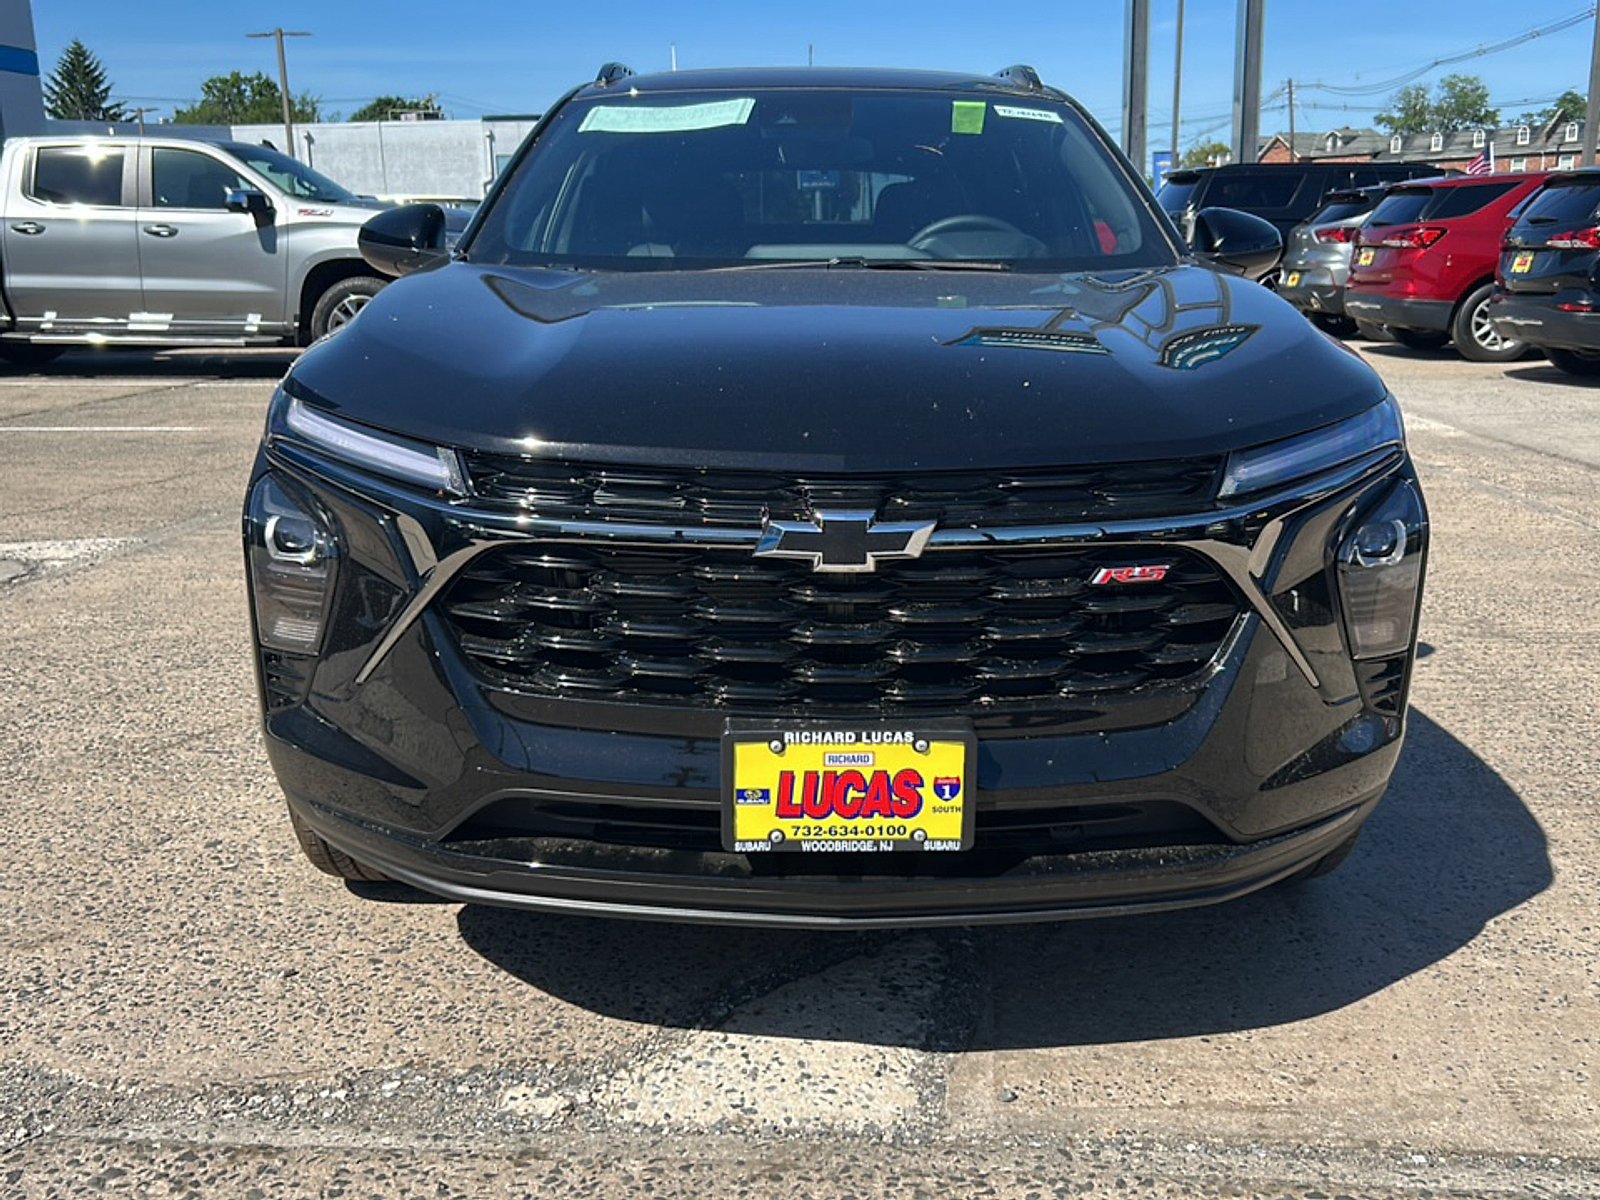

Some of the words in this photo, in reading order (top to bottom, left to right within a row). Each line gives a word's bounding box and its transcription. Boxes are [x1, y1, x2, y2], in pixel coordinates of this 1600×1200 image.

[1092, 564, 1170, 584] RS
[784, 731, 857, 744] RICHARD
[861, 731, 915, 744] LUCAS
[828, 754, 871, 764] RICHARD
[775, 769, 925, 819] LUCAS
[941, 784, 953, 800] 1
[932, 805, 962, 813] SOUTH
[790, 825, 908, 836] 732-634-0100
[734, 841, 771, 852] SUBARU
[879, 840, 894, 852] NJ
[923, 841, 961, 851] SUBARU
